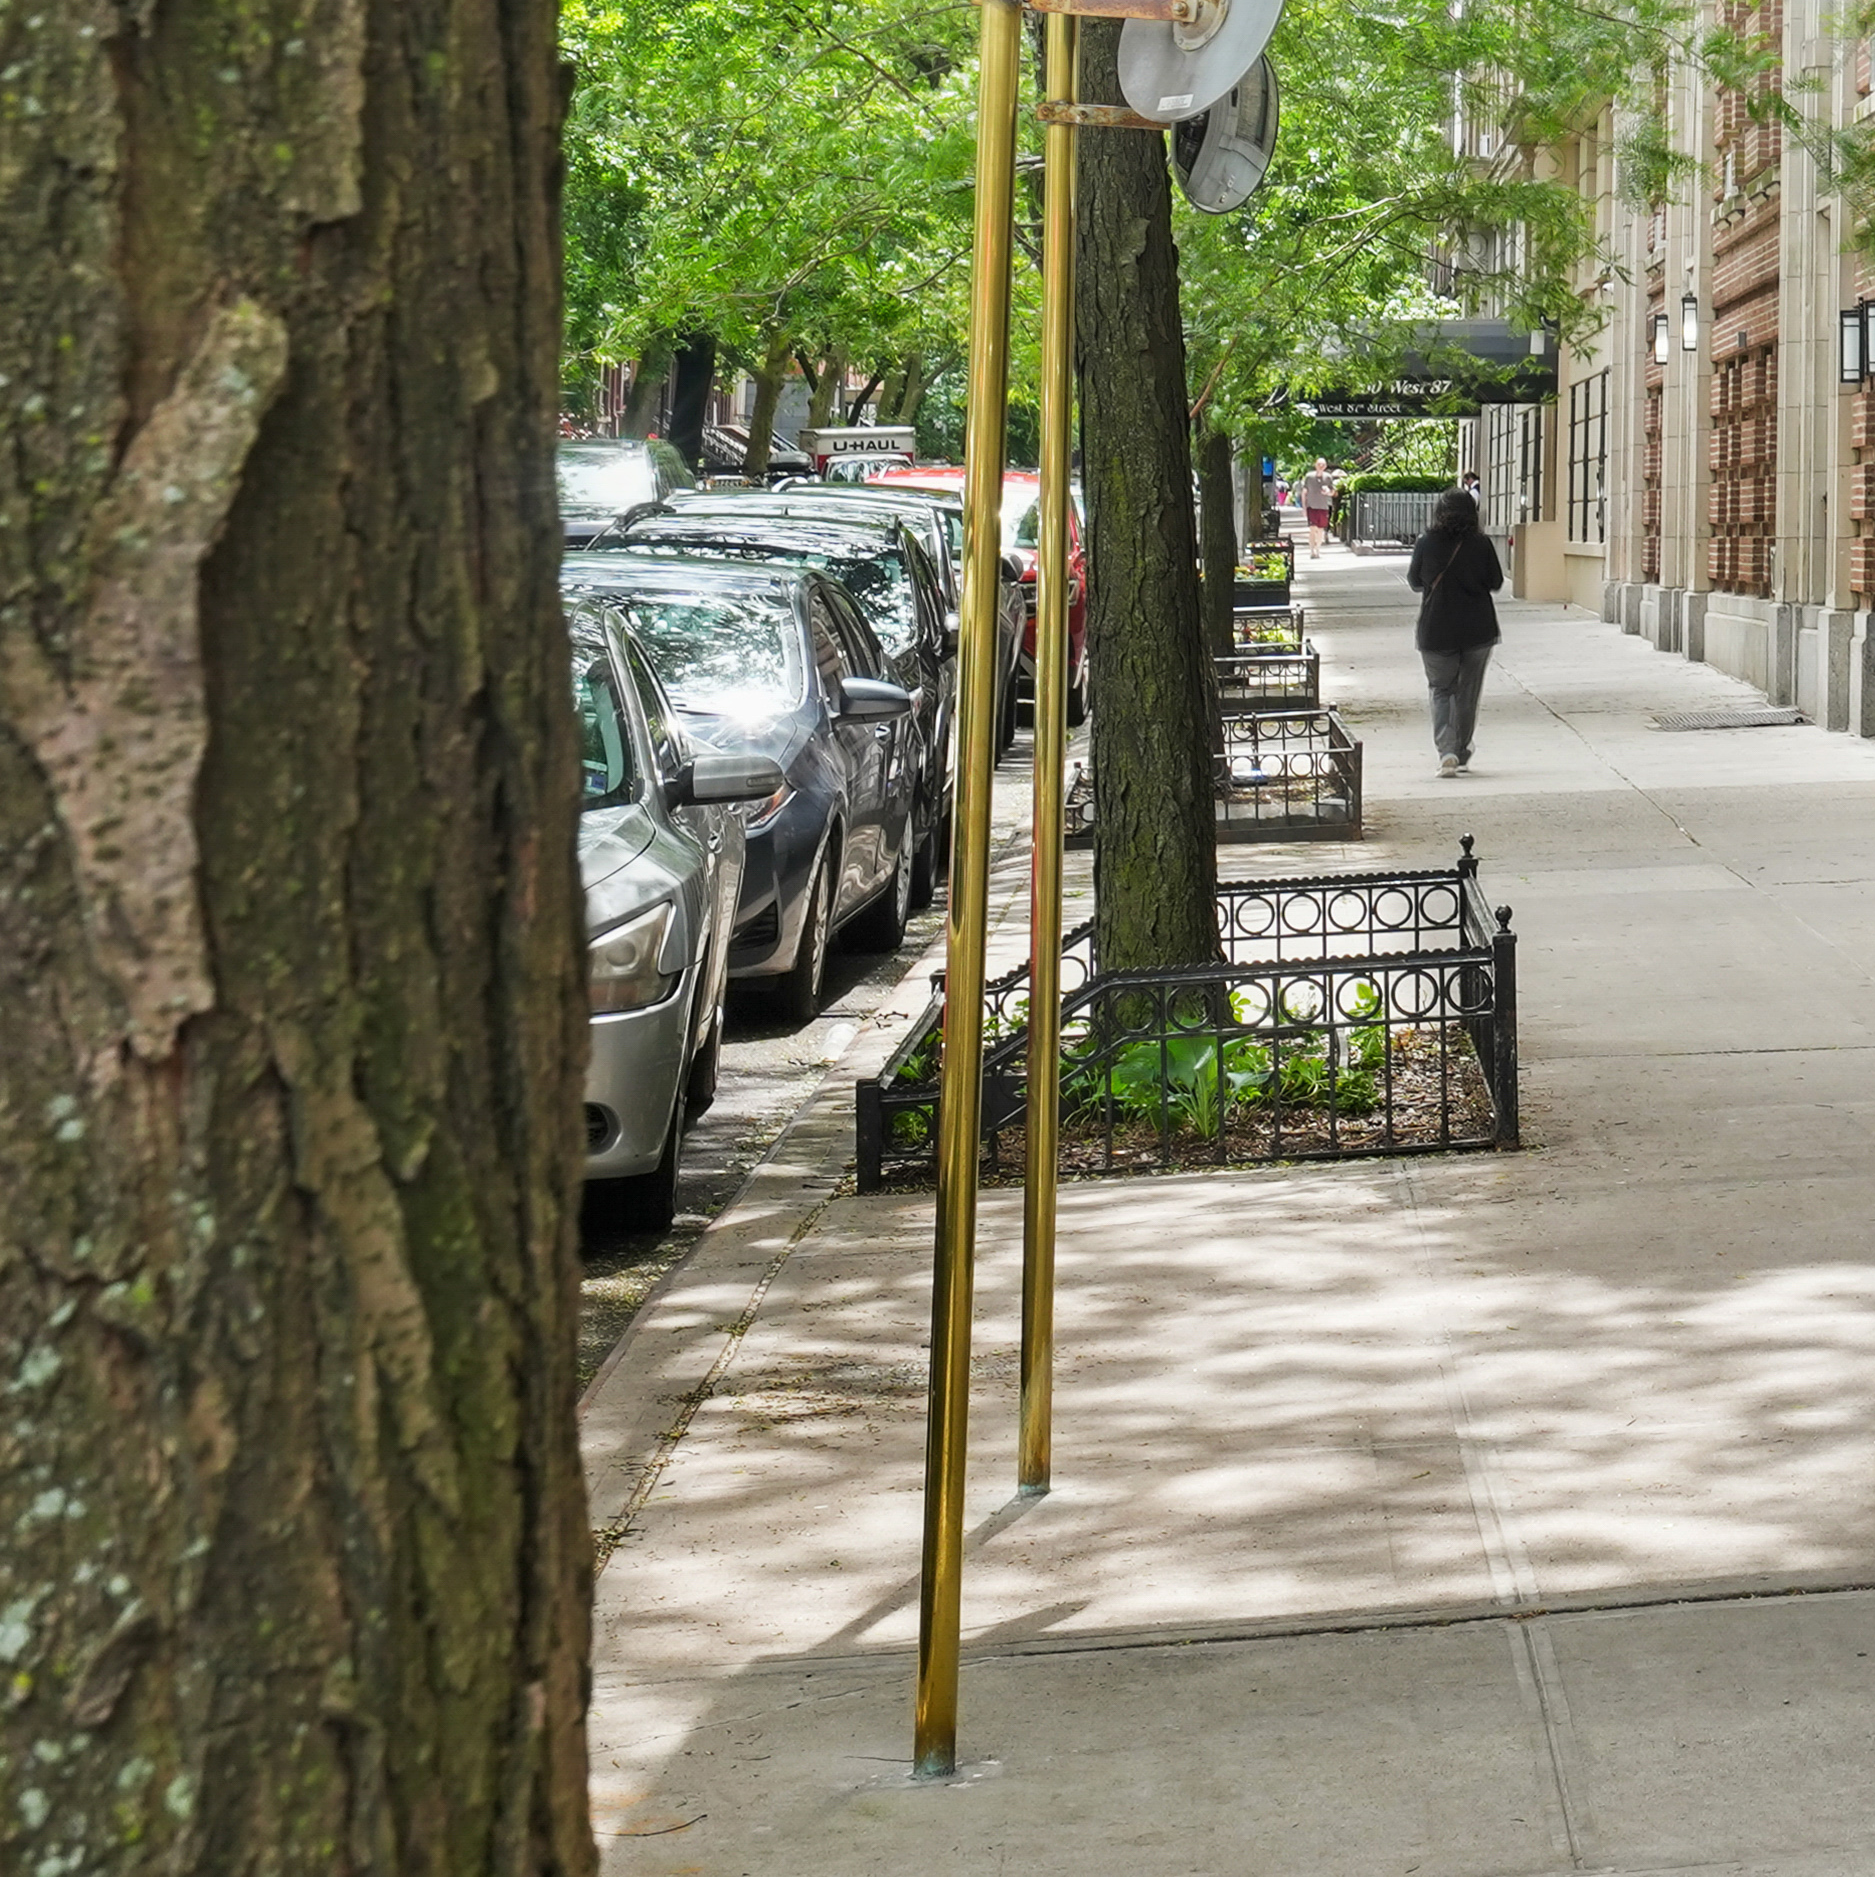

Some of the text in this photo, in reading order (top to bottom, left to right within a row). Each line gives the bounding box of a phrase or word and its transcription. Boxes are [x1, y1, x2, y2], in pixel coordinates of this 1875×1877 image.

[1391, 379, 1430, 394] West
[1429, 379, 1453, 394] 87
[833, 439, 901, 452] U-HAUL
